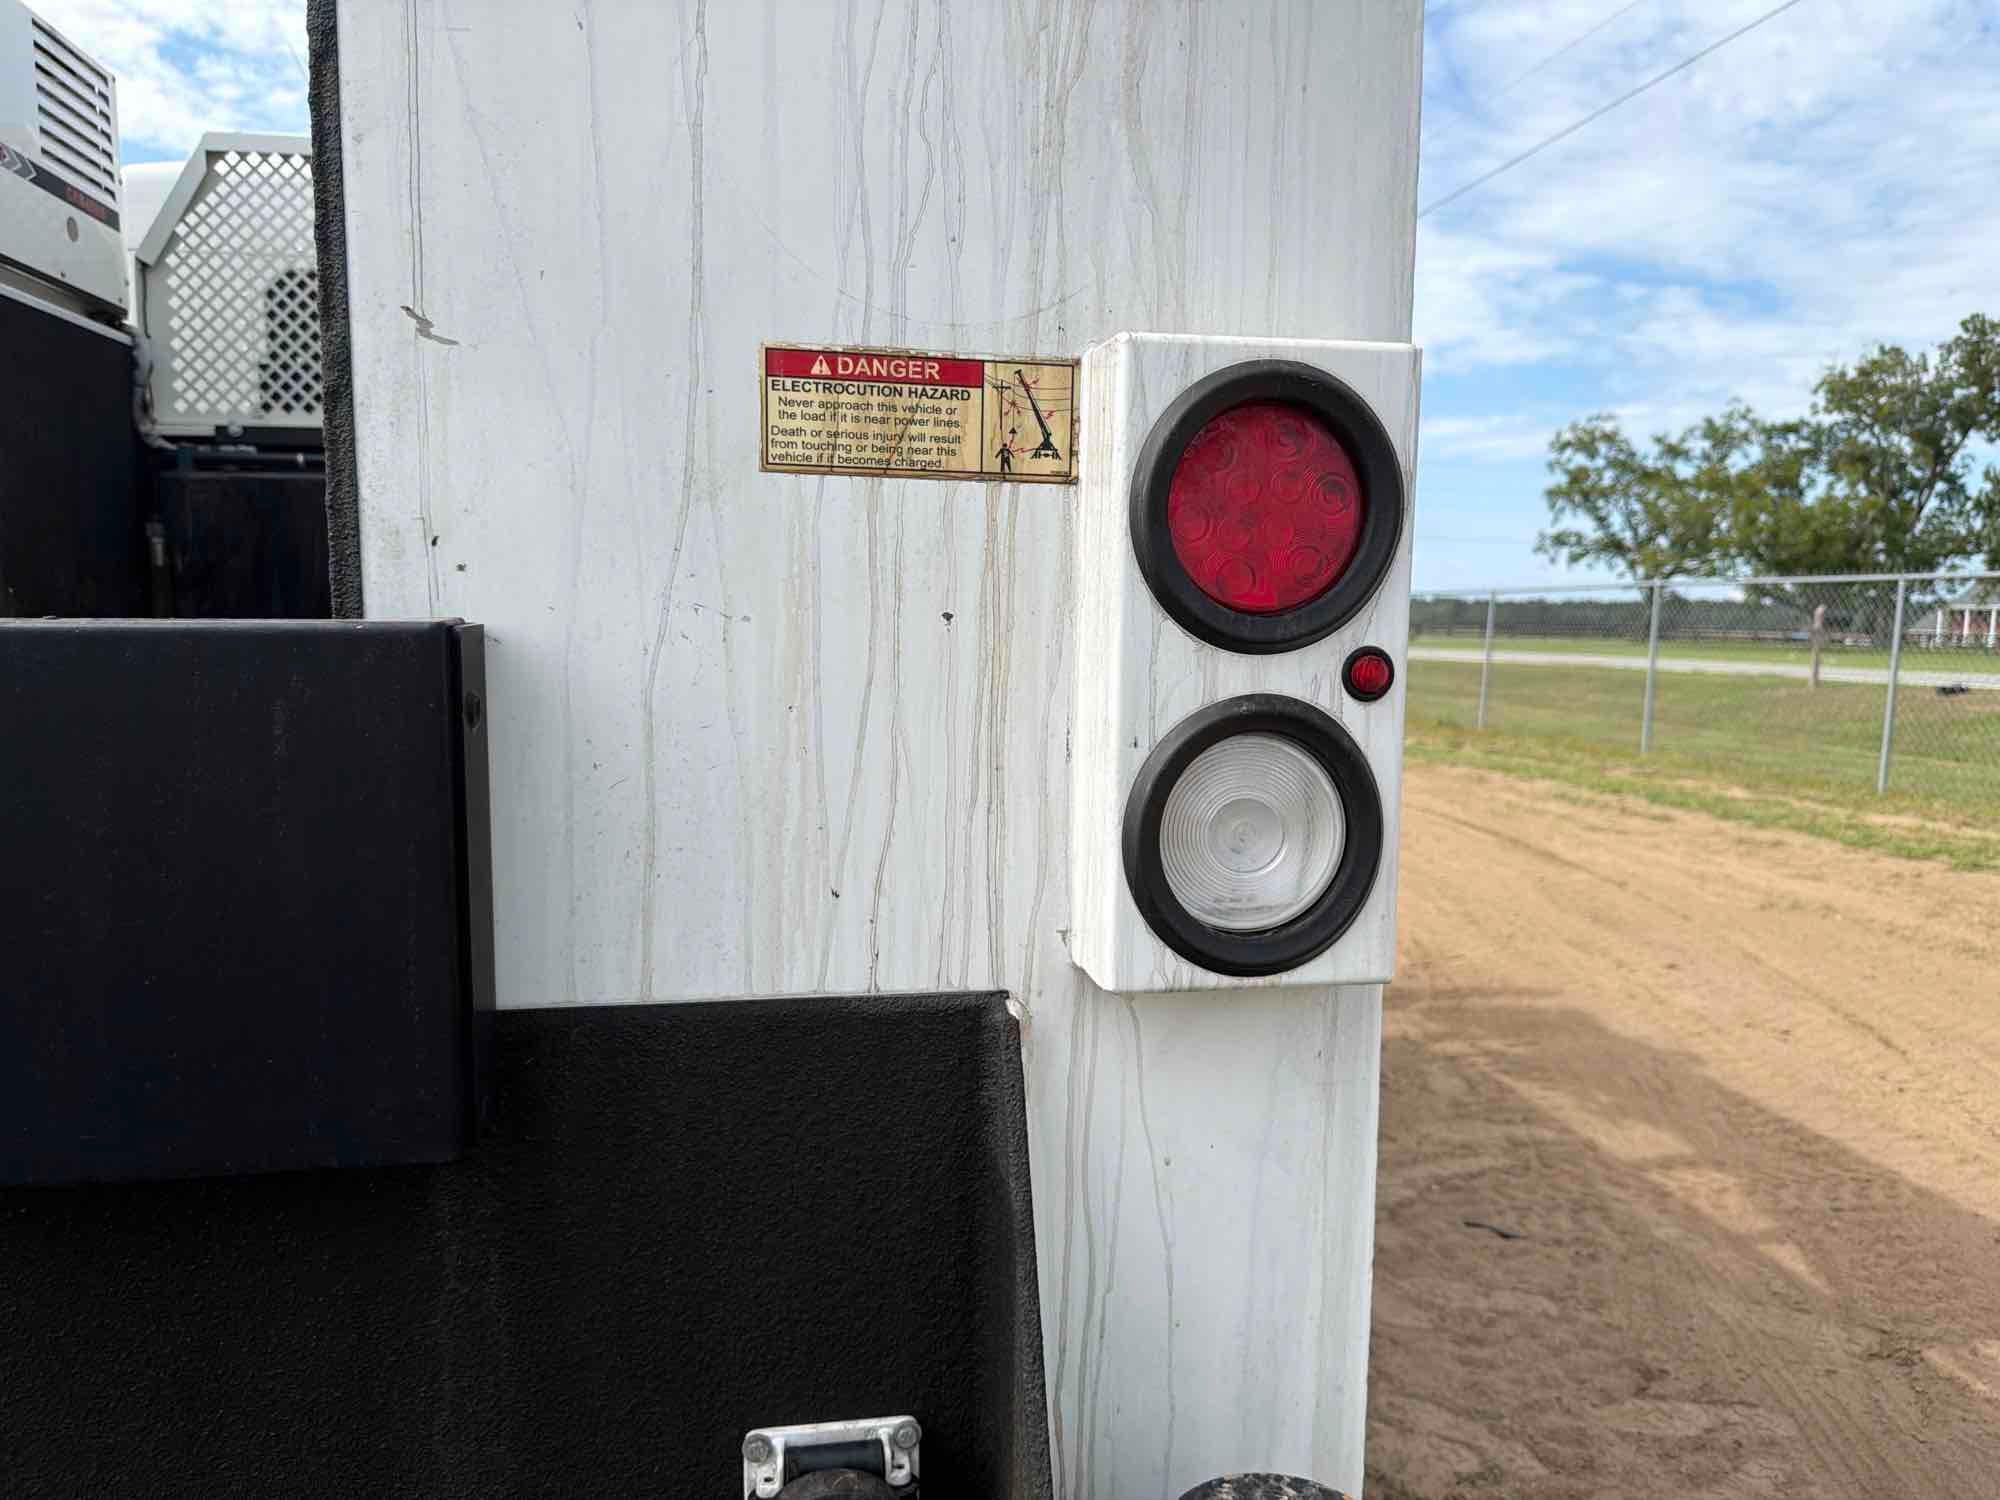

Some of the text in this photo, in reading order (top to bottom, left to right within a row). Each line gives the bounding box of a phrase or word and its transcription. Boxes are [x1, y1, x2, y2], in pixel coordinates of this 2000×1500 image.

[837, 356, 940, 380] DANGER
[771, 379, 971, 401] ELECTROCUTION HAZARD
[778, 396, 958, 416] Never approach this vehicle or
[778, 410, 797, 420] the
[800, 410, 826, 421] load
[830, 411, 838, 422] if
[840, 413, 847, 423] it
[850, 413, 862, 424] is
[864, 414, 892, 425] near
[894, 417, 930, 427] power
[770, 425, 961, 445] Death or serious injury will result
[771, 438, 957, 457] from touching or being near this
[771, 451, 945, 471] vehicle if it becomes charged.
